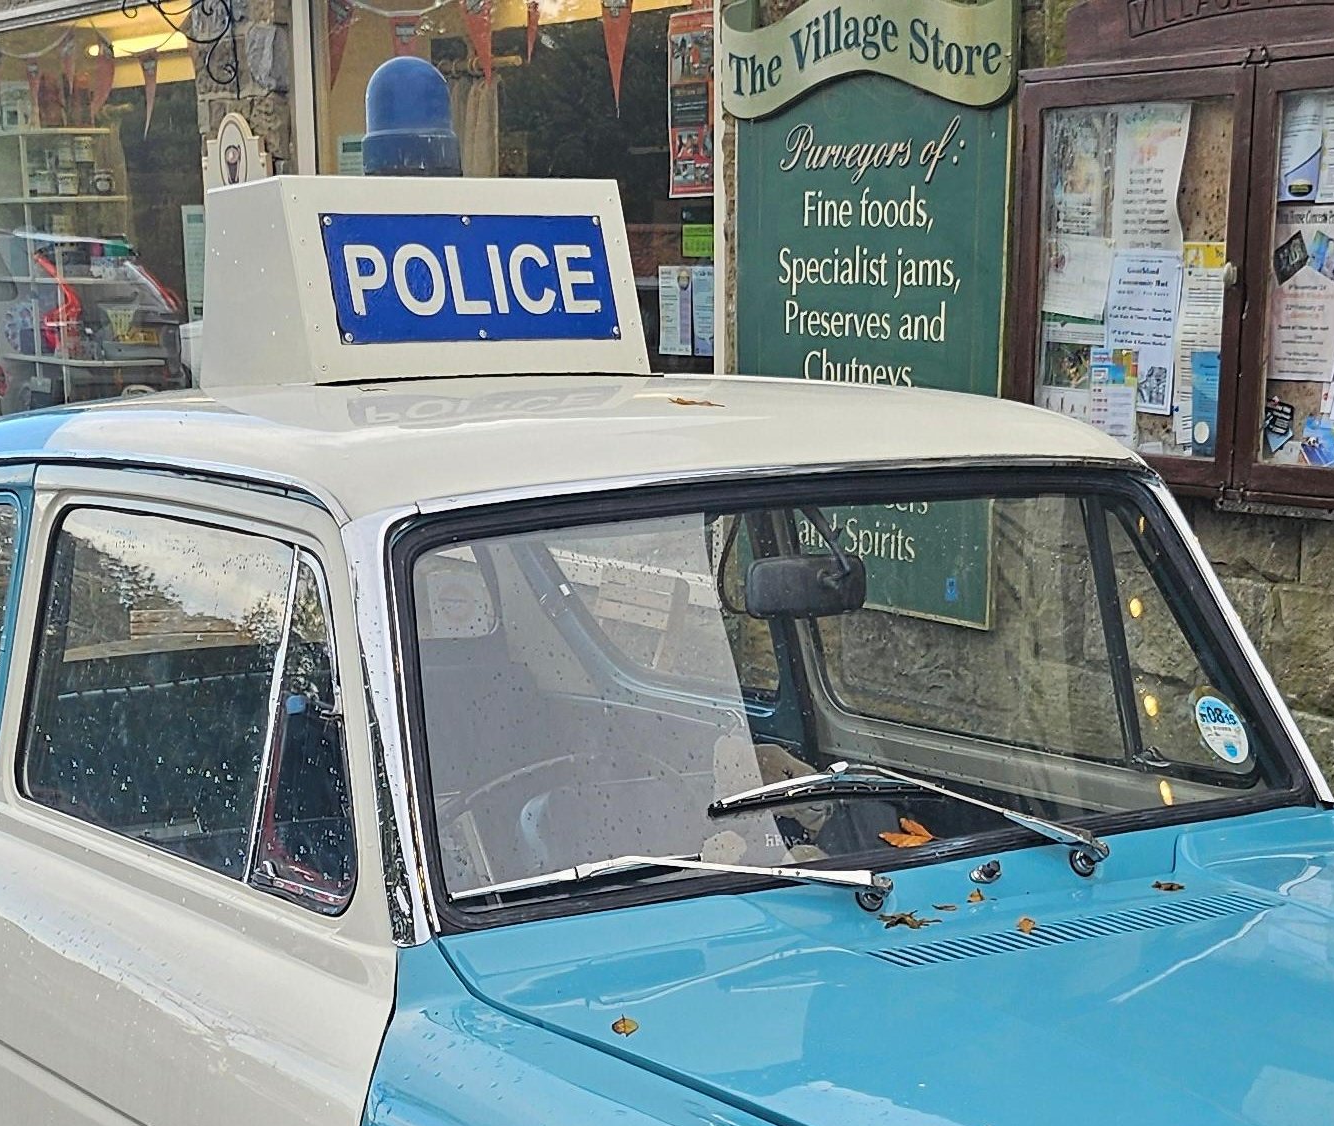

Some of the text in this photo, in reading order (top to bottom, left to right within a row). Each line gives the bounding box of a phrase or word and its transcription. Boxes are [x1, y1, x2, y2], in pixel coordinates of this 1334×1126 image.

[729, 6, 1002, 96] The Village Store
[779, 123, 913, 184] Purveyors
[803, 186, 934, 234] Fine foods,
[343, 243, 602, 316] POLICE
[778, 245, 961, 299] Specialist jams,
[785, 300, 946, 342] Preserves and
[845, 517, 916, 562] Spirits
[1207, 706, 1225, 723] 08
